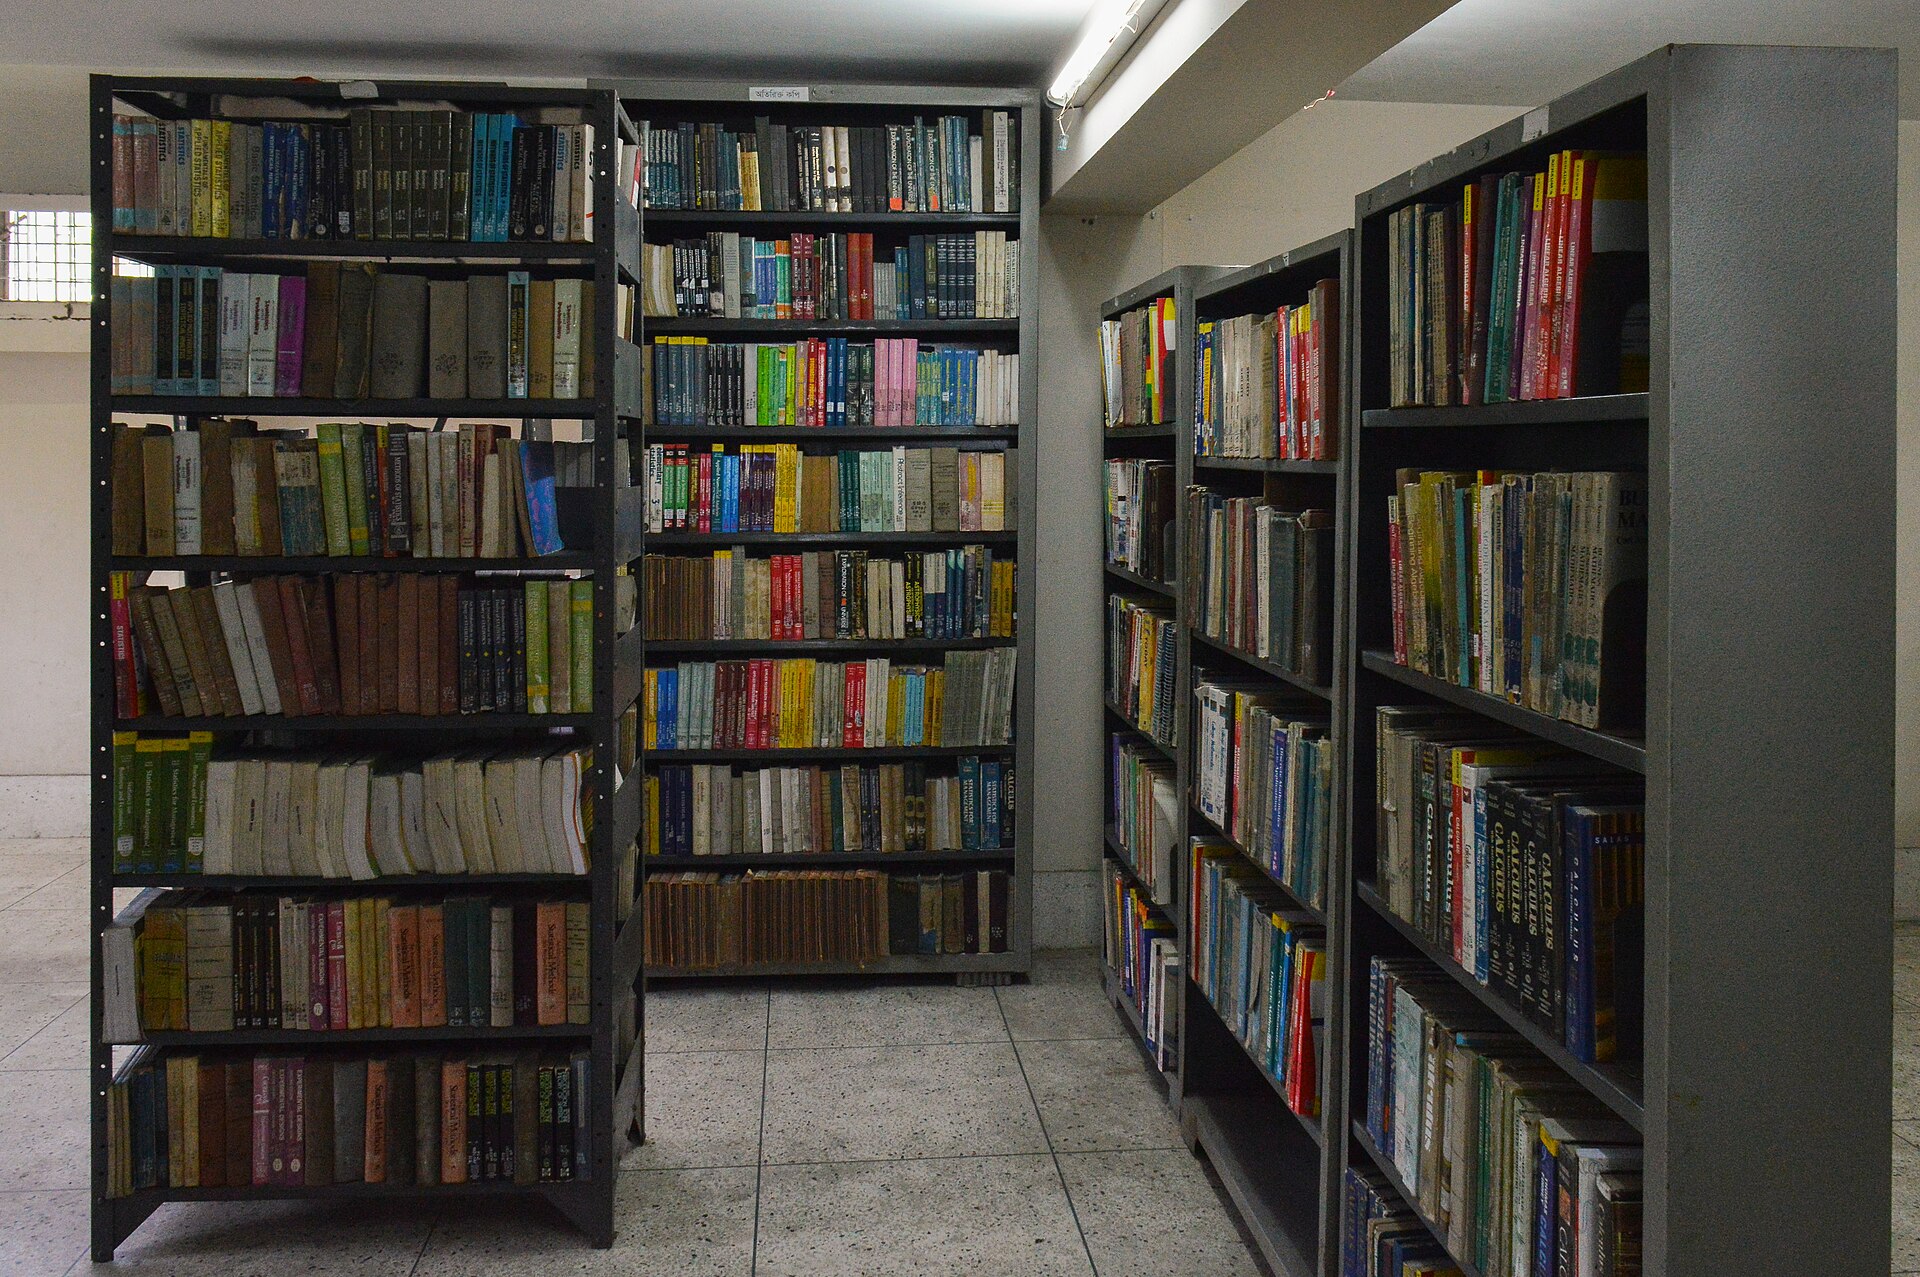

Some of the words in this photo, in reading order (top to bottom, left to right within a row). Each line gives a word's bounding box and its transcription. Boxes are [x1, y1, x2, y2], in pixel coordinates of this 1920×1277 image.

[1542, 269, 1550, 304] ALGEBRA
[655, 448, 663, 485] elementary
[1426, 803, 1434, 902] Calculus
[1446, 812, 1454, 913] Calculus
[1494, 822, 1505, 914] CALCULUS
[1511, 832, 1521, 925] CALCULUS
[1528, 840, 1538, 936] CALCULUS
[1542, 853, 1553, 950] CALCULUS
